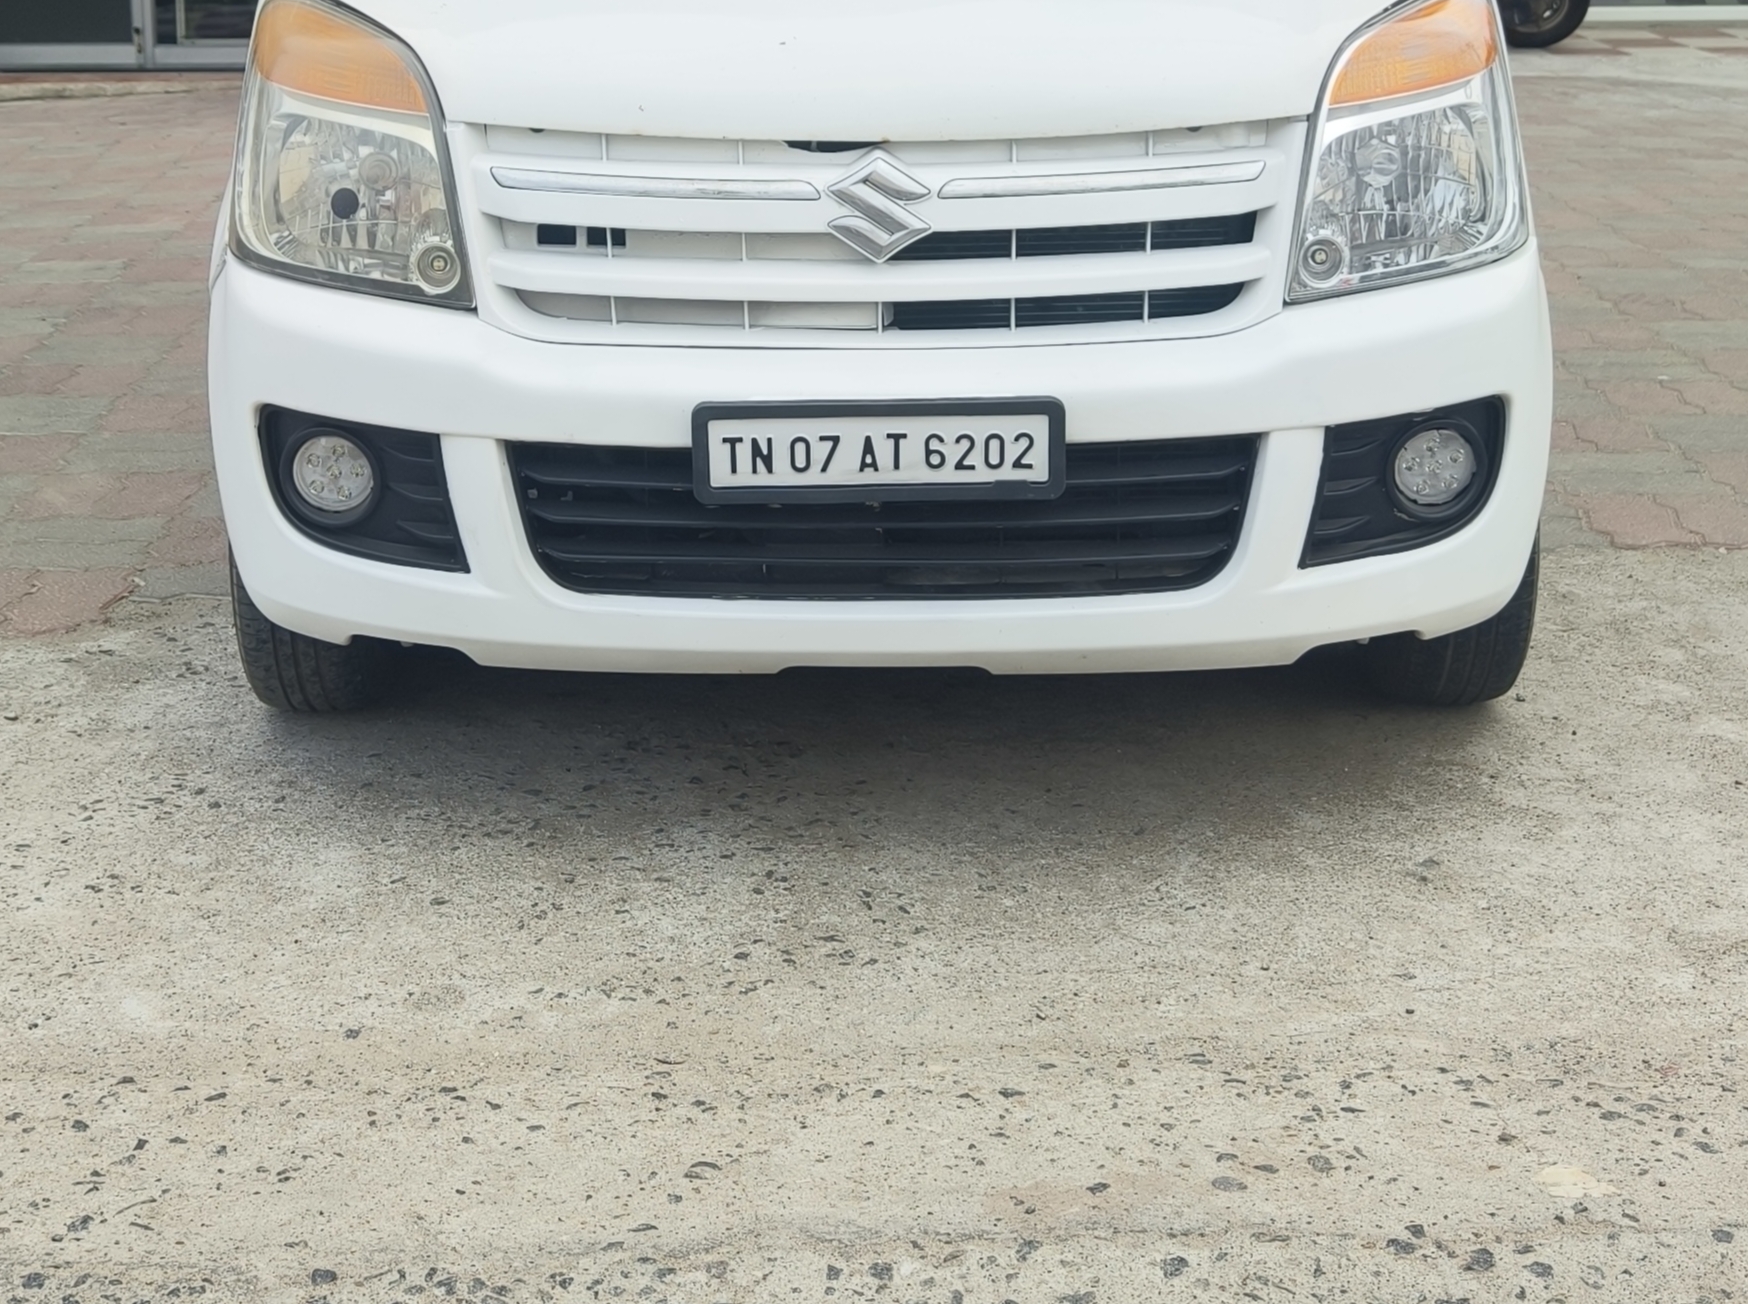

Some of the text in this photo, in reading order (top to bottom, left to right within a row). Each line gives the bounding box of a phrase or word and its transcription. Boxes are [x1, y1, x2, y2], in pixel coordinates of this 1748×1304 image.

[721, 431, 1035, 475] TN 07 AT 6202
